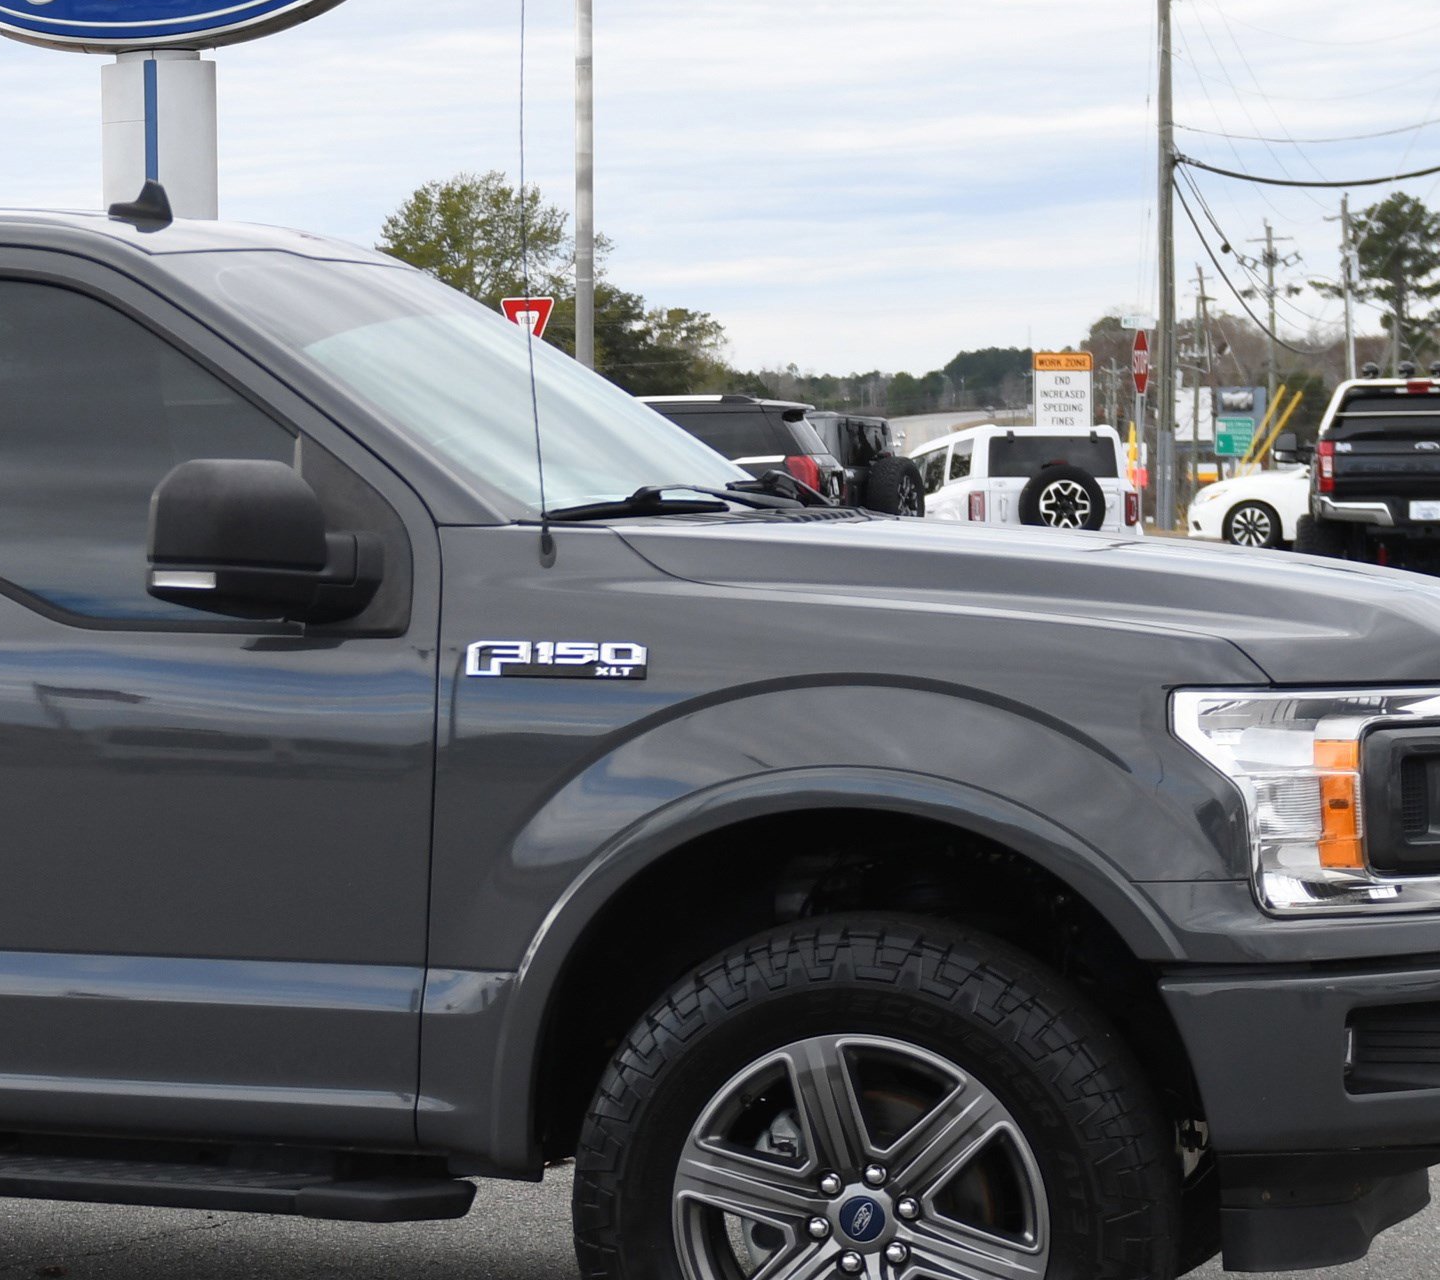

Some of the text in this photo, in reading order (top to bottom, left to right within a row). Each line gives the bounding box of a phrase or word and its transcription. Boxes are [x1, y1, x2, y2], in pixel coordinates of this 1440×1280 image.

[1038, 358, 1086, 367] WORK ZONE
[1054, 376, 1071, 385] END
[1040, 390, 1086, 400] INCREASED
[1043, 403, 1083, 412] SPEEDING
[1051, 416, 1075, 426] FINES
[594, 666, 634, 677] XLT
